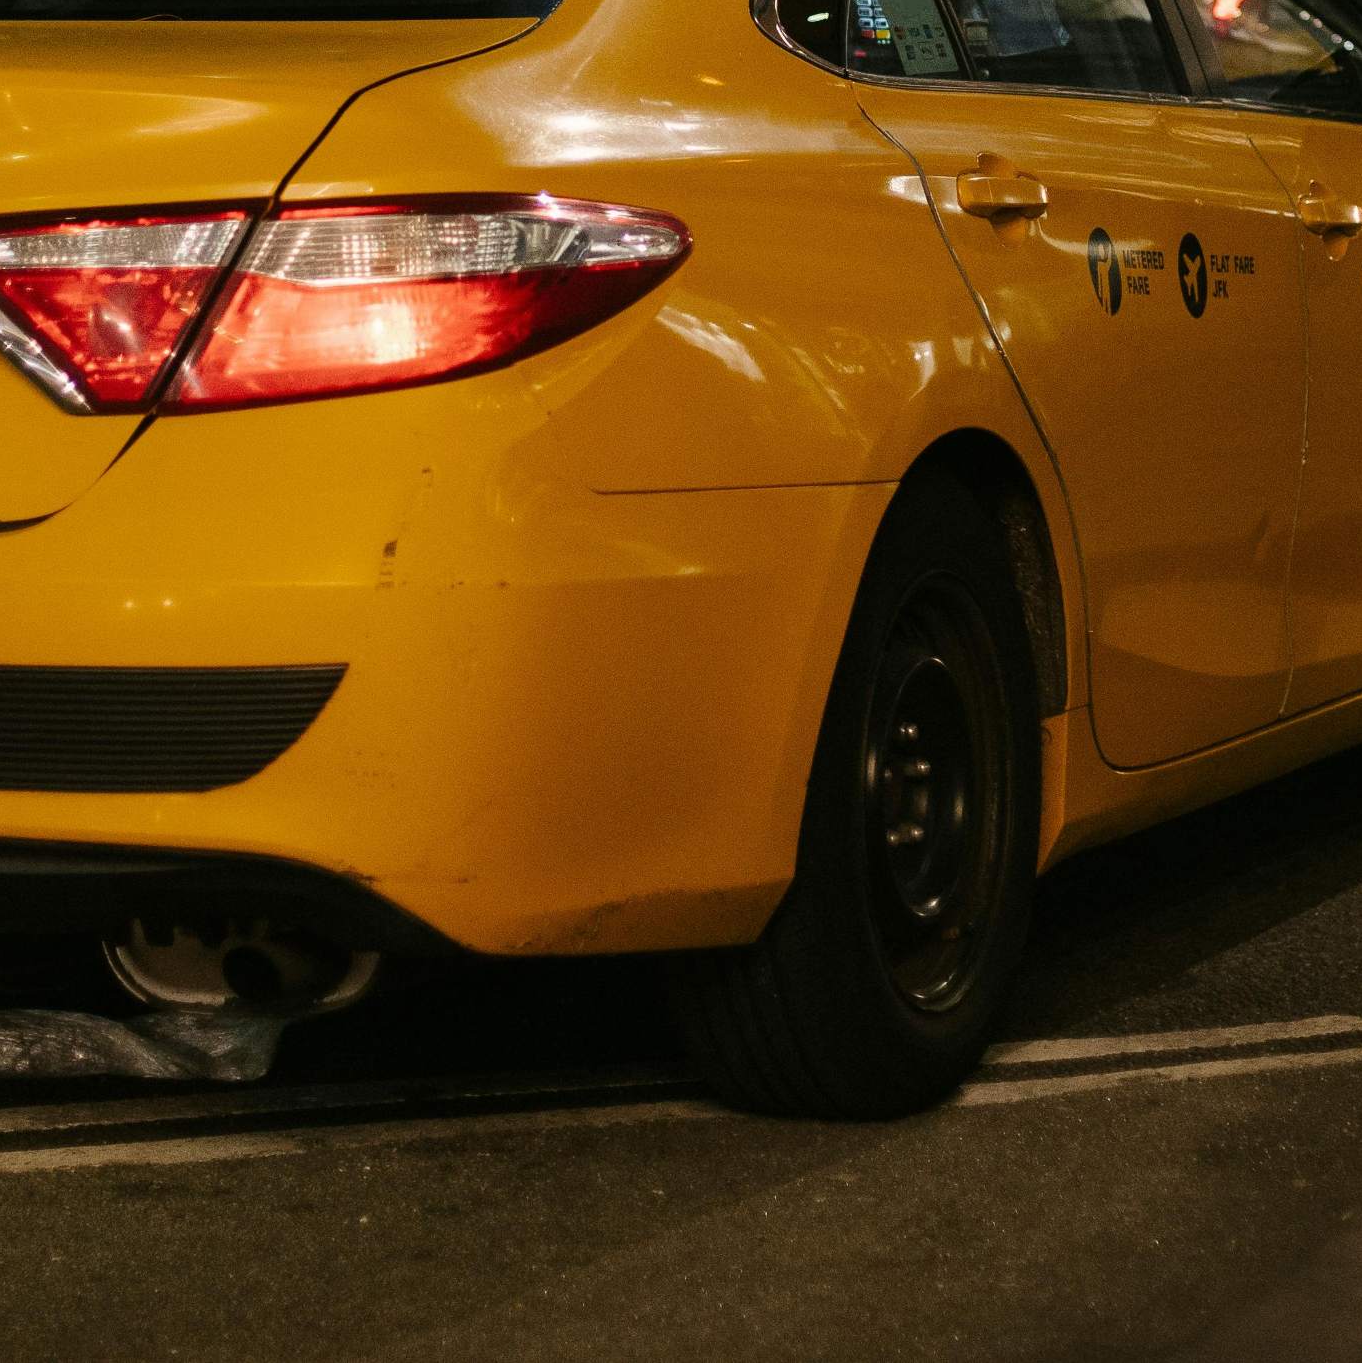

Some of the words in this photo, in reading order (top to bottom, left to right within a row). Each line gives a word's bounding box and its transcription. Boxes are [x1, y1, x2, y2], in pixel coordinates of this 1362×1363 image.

[1122, 250, 1165, 271] METERED
[1210, 254, 1230, 274] FLAT
[1234, 255, 1255, 275] FARE
[1126, 275, 1150, 296] FARE
[1212, 279, 1229, 299] JFK
